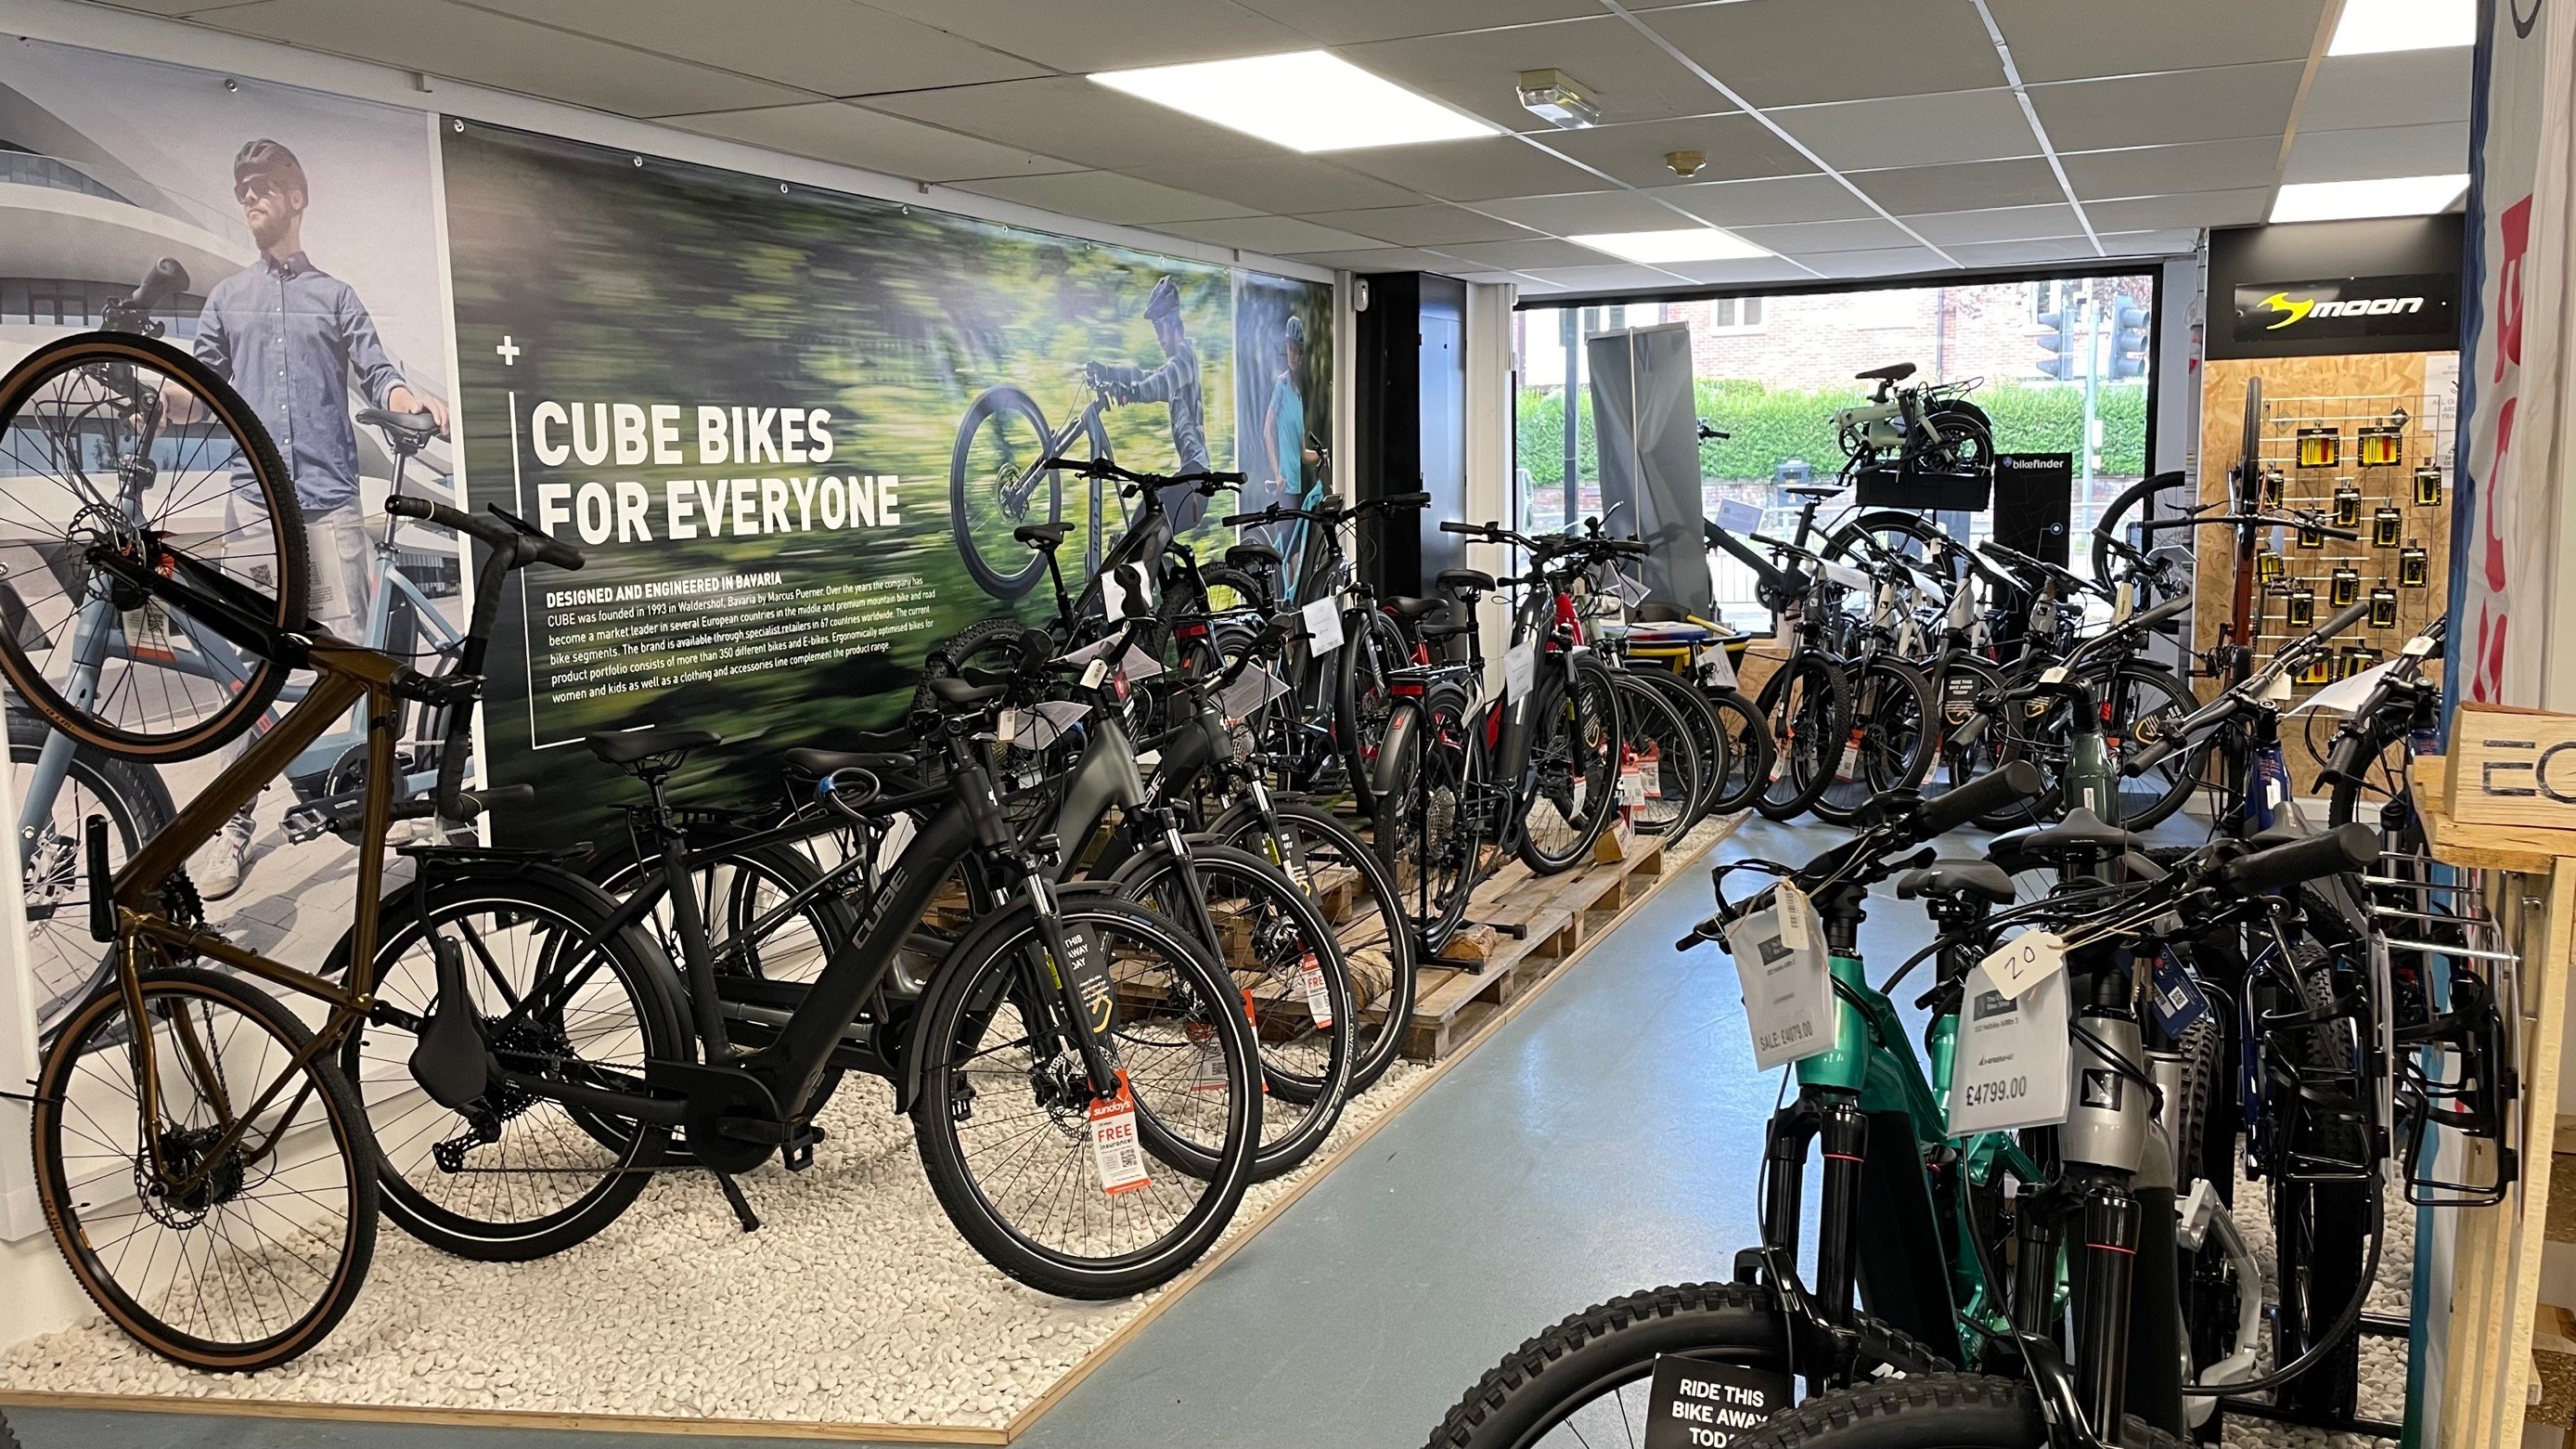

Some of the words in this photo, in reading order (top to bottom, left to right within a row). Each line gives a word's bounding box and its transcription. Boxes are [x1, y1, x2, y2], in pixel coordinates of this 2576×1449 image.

[2308, 297, 2424, 318] moon
[532, 400, 683, 467] CUBE
[697, 406, 834, 464] BIKES
[2013, 459, 2064, 470] bikefinder
[537, 482, 653, 545] FOR
[665, 475, 901, 540] EVERYONE
[547, 587, 613, 608] DESIGNED
[615, 584, 643, 602] AND
[645, 577, 720, 598] ENGINEERED
[722, 576, 733, 589] IN
[735, 571, 782, 589] BAVARIA
[547, 613, 576, 627] CUBE
[577, 614, 597, 625] was
[599, 608, 635, 622] founded
[637, 607, 645, 617] in
[647, 603, 667, 616] 1993
[668, 602, 676, 614] in
[678, 598, 727, 612] Waldershof,
[728, 594, 756, 606] Bavaria
[757, 593, 766, 605] by
[768, 589, 794, 602] Marcus
[795, 588, 825, 599] Puerner.
[826, 585, 842, 596] Over
[843, 584, 854, 594] the
[855, 582, 872, 595] years
[873, 581, 883, 590] the
[884, 577, 911, 590] company
[912, 576, 923, 586] has
[548, 632, 586, 647] become
[588, 632, 595, 641] a
[597, 626, 628, 640] market
[630, 622, 659, 637] leader
[660, 621, 668, 632] in
[670, 618, 700, 631] several
[702, 615, 739, 629] European
[740, 609, 775, 623] countries
[776, 607, 783, 617] in
[785, 604, 796, 616] the
[798, 602, 821, 615] middle
[822, 601, 835, 612] and
[836, 598, 866, 613] premium
[867, 595, 895, 606] mountain
[896, 592, 909, 602] bike
[910, 590, 921, 601] and
[922, 589, 936, 599] road
[550, 652, 571, 666] bike
[573, 647, 621, 664] segments.
[623, 642, 639, 655] The
[640, 639, 665, 653] brand
[667, 638, 676, 650] is
[676, 632, 713, 648] available
[714, 628, 744, 644] through
[745, 626, 780, 640] specialist
[781, 621, 812, 636] retailers
[812, 619, 819, 629] in
[820, 618, 829, 628] 67
[830, 615, 861, 627] countries
[861, 610, 895, 623] worldwide.
[896, 607, 908, 617] The
[908, 605, 930, 616] current
[551, 668, 587, 688] product
[589, 664, 628, 682] portfolio
[629, 658, 665, 673] consists
[666, 657, 676, 668] of
[676, 654, 699, 666] more
[700, 649, 717, 662] than
[719, 647, 733, 660] 350
[734, 643, 766, 657] different
[767, 640, 787, 653] bikes
[788, 637, 802, 649] and
[803, 634, 831, 647] E-bikes.
[831, 627, 878, 644] Ergonomically
[878, 623, 908, 637] optimised
[908, 620, 925, 631] bikes
[925, 618, 934, 628] for
[551, 689, 587, 704] women
[589, 684, 606, 698] and
[608, 679, 627, 694] kids
[628, 680, 639, 691] as
[641, 677, 659, 689] well
[661, 676, 672, 686] as
[673, 675, 678, 683] a
[680, 668, 713, 684] clothing
[713, 665, 728, 679] and
[729, 659, 773, 677] accessories
[774, 654, 789, 666] line
[790, 649, 832, 666] complement
[833, 647, 844, 658] the
[845, 643, 870, 658] product
[870, 640, 891, 653] range.
[852, 866, 909, 950] CUBE
[1072, 957, 1086, 971] DAY
[2004, 946, 2036, 980] 20
[1307, 976, 1324, 989] FRE
[1758, 1030, 1781, 1052] SALE:
[1781, 1020, 1813, 1046] £4079.00
[1965, 1075, 2027, 1106] £4799.00
[1098, 1123, 1132, 1143] FREE
[1100, 1136, 1133, 1150] insurance!
[1680, 1378, 1720, 1401] RIDE
[1724, 1385, 1764, 1408] THIS
[1671, 1401, 1713, 1423] BIKE
[1689, 1427, 1734, 1449] TOD
